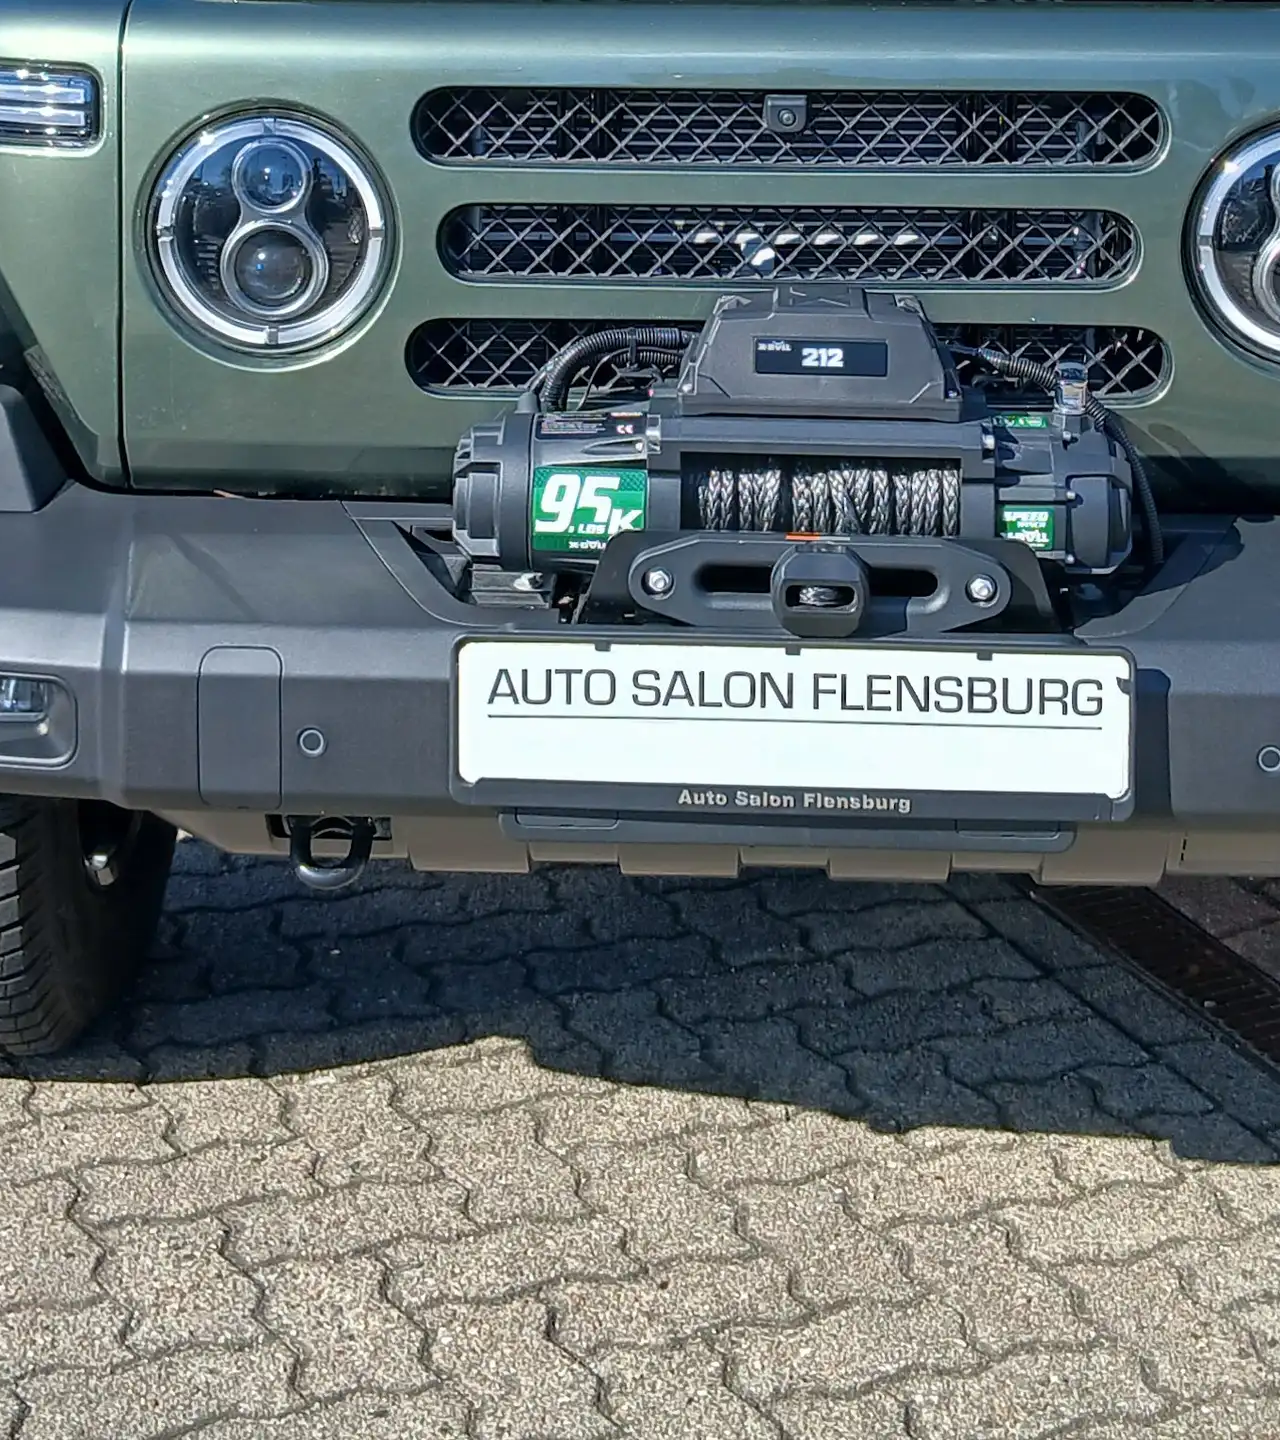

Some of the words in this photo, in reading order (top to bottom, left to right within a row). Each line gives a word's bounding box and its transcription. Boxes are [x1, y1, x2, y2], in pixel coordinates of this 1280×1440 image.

[801, 347, 844, 367] 212
[487, 668, 617, 706] AUTO
[632, 669, 794, 709] SALON
[812, 672, 1104, 716] FLENSBURG
[678, 789, 728, 807] Auto
[735, 790, 796, 809] Salon
[803, 792, 912, 814] Flensburg
